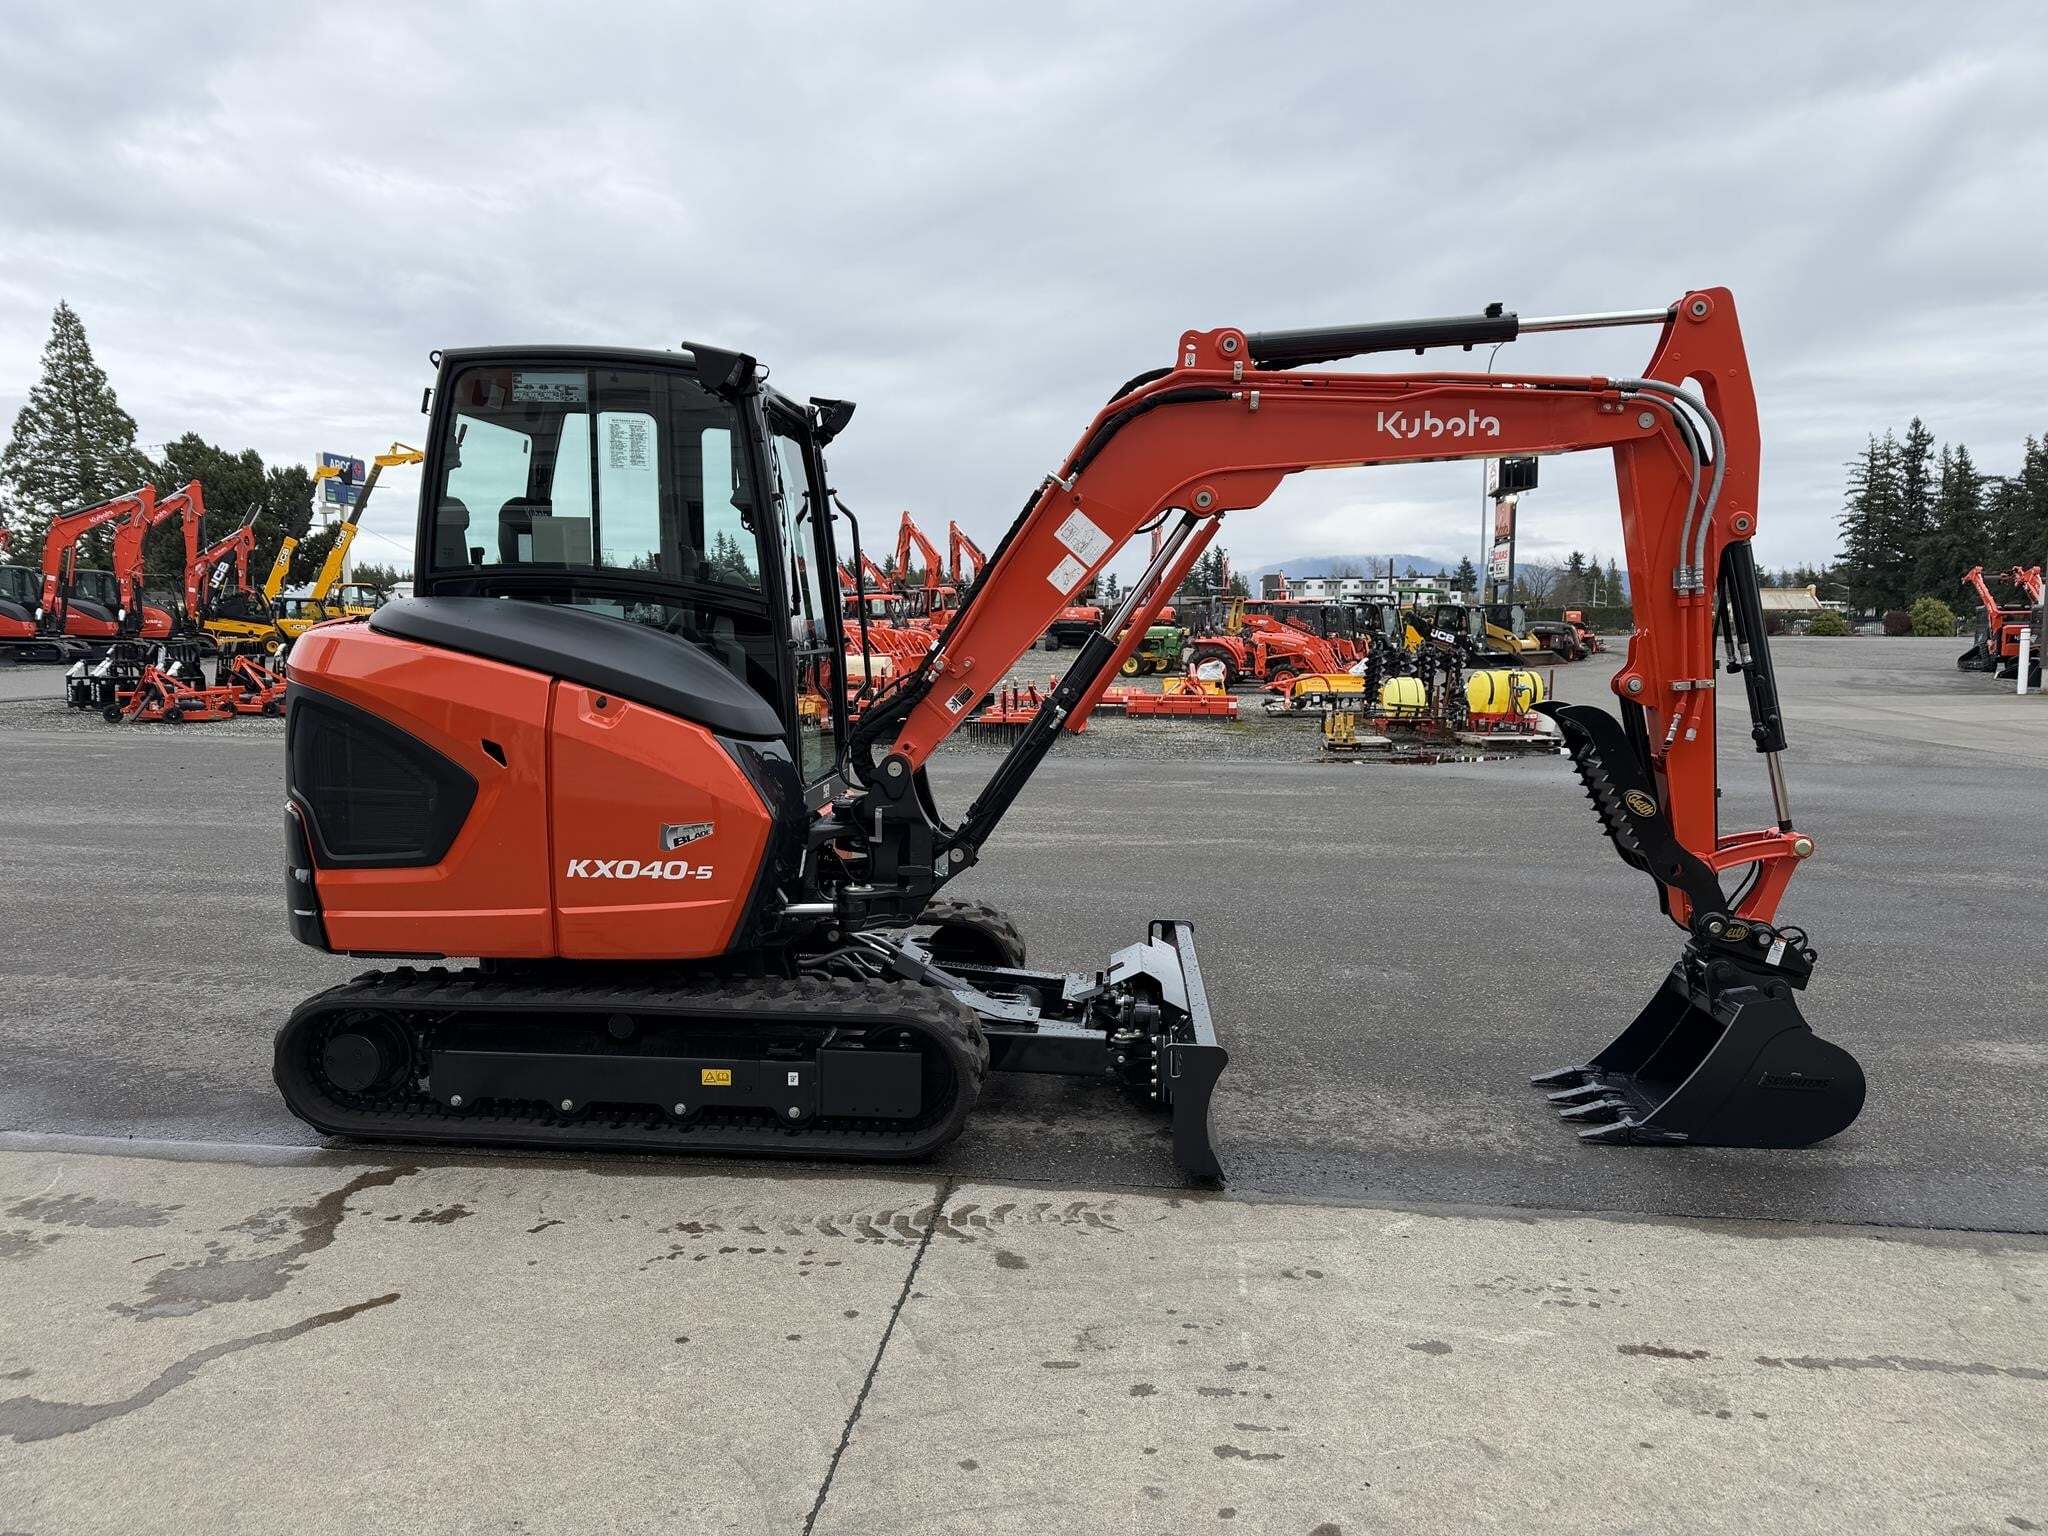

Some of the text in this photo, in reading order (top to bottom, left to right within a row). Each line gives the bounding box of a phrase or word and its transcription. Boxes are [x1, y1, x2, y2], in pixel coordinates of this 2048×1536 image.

[1377, 409, 1500, 439] Kubota
[279, 547, 290, 567] JCB
[209, 561, 230, 589] JCB
[1430, 628, 1456, 644] JCB
[566, 859, 714, 880] KX040-5
[1725, 926, 1746, 939] eith
